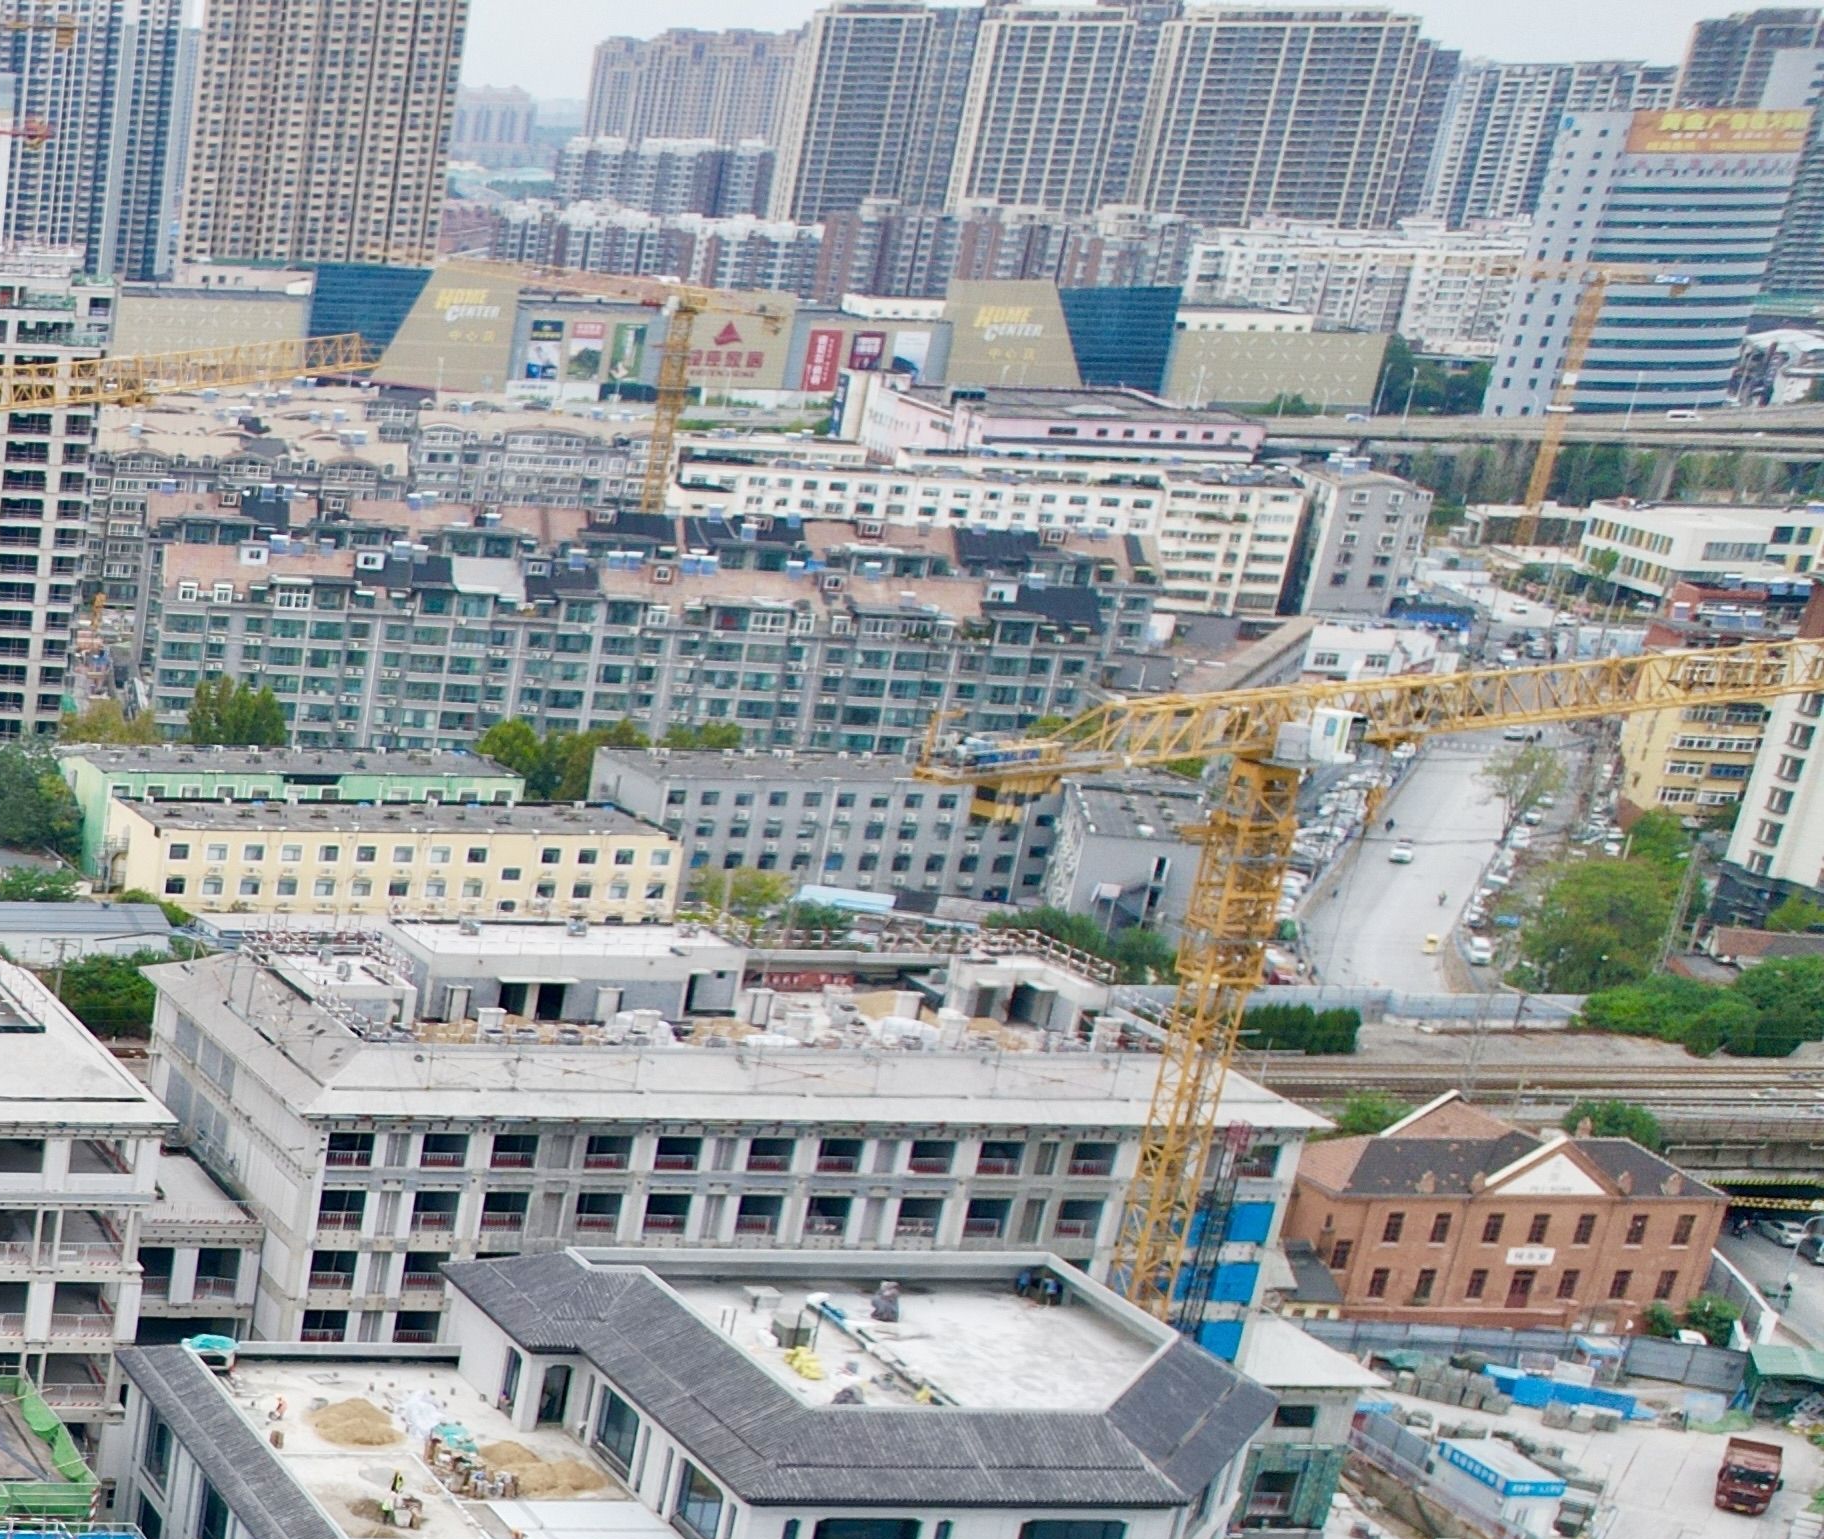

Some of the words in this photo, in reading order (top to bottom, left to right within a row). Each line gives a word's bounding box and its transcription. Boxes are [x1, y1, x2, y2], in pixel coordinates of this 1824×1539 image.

[435, 288, 489, 305] HOME
[445, 304, 500, 321] CENTER
[974, 306, 1030, 324] HOME
[984, 322, 1044, 341] CENTER
